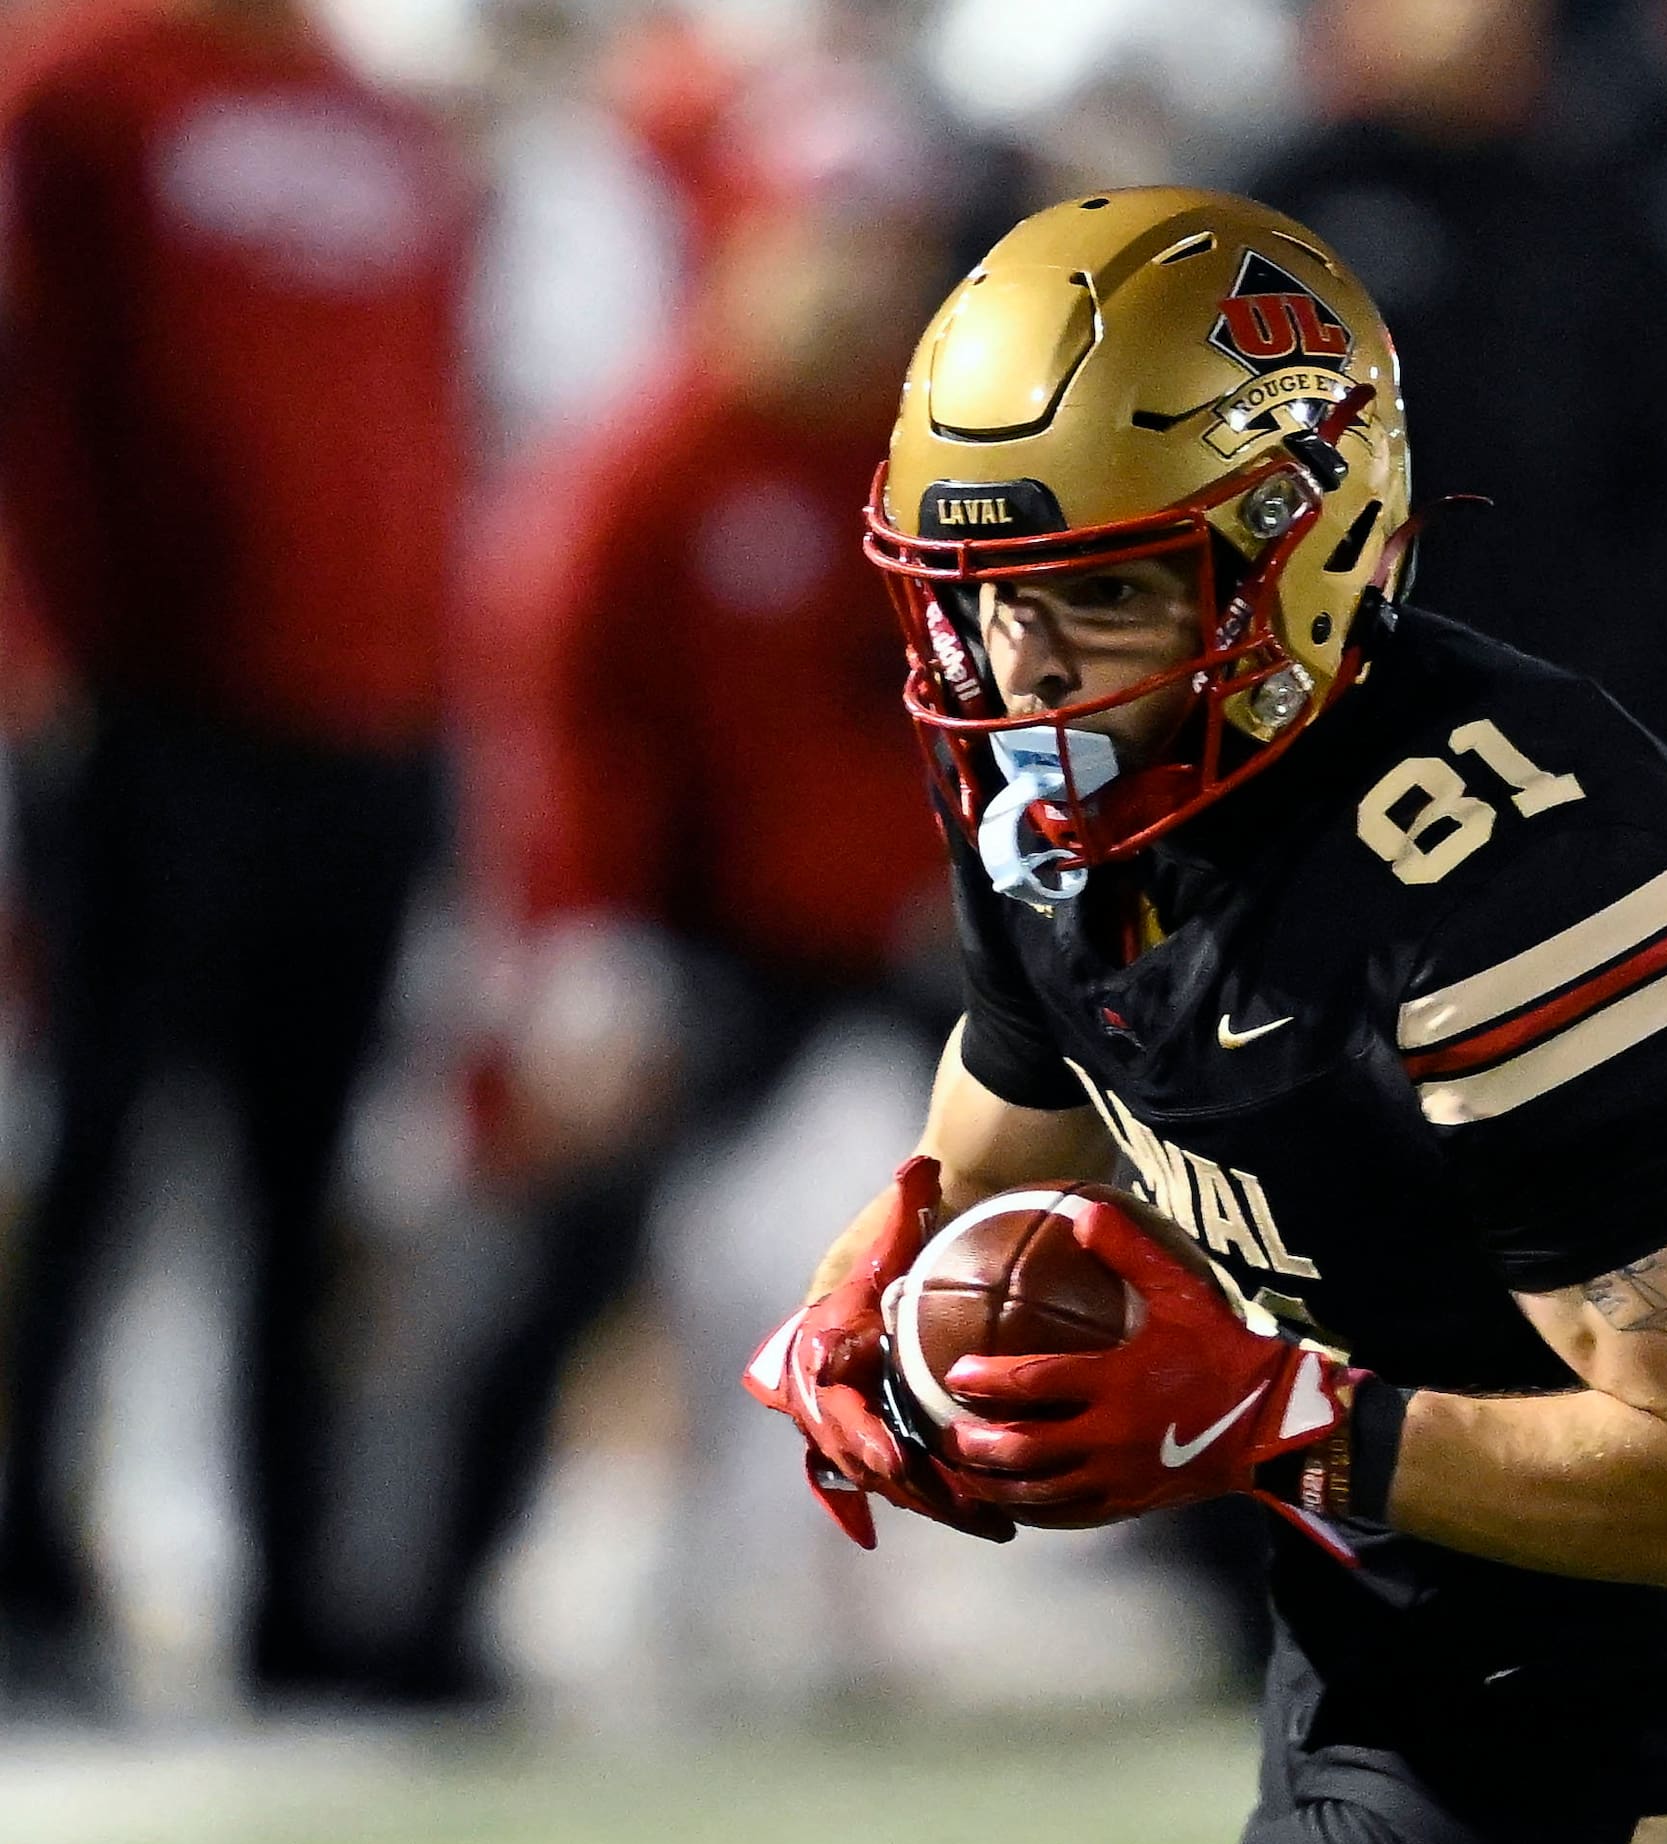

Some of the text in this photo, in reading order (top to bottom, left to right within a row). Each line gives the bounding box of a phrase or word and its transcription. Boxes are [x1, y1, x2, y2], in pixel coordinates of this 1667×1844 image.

[1217, 292, 1348, 359] UL
[937, 497, 1014, 525] LAVAL
[1357, 718, 1587, 885] 81
